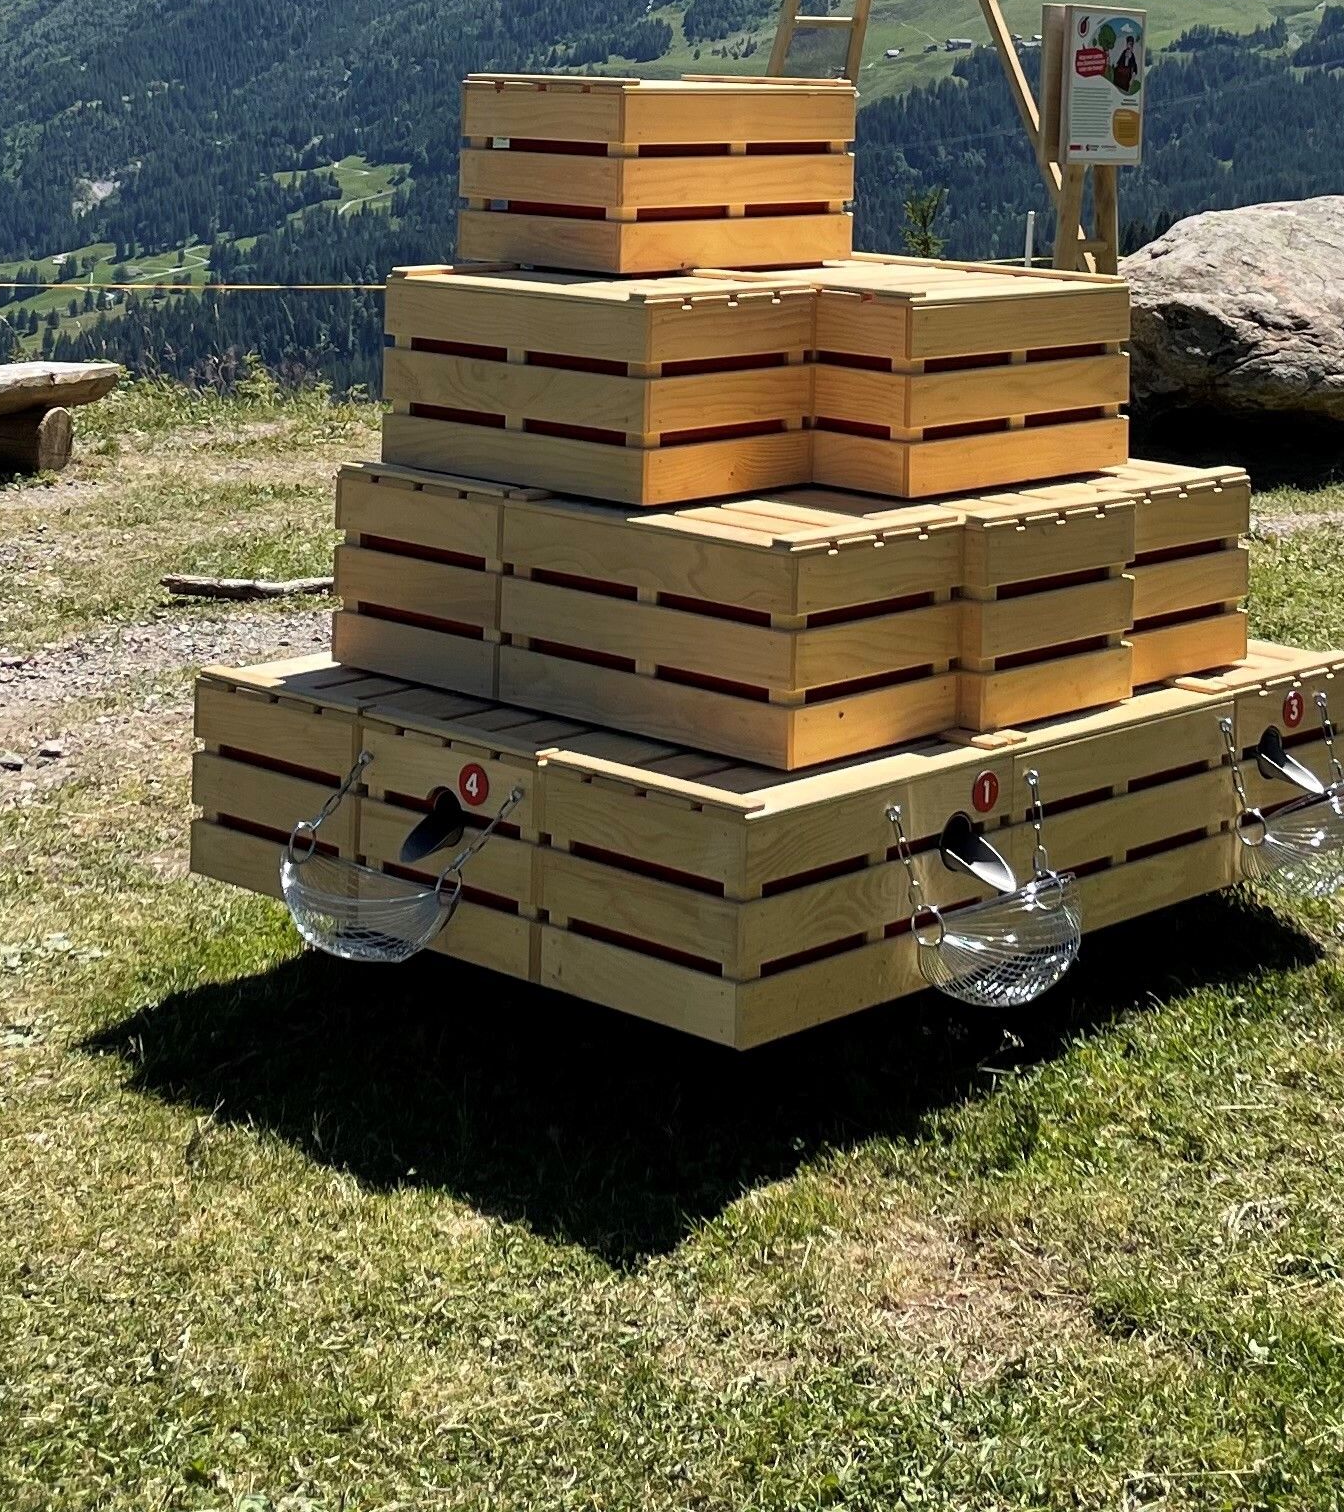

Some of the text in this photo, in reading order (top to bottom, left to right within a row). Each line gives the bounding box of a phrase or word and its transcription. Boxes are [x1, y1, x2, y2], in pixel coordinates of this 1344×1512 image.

[1290, 698, 1298, 720] 3
[466, 772, 478, 797] 4
[984, 780, 990, 804] 1
